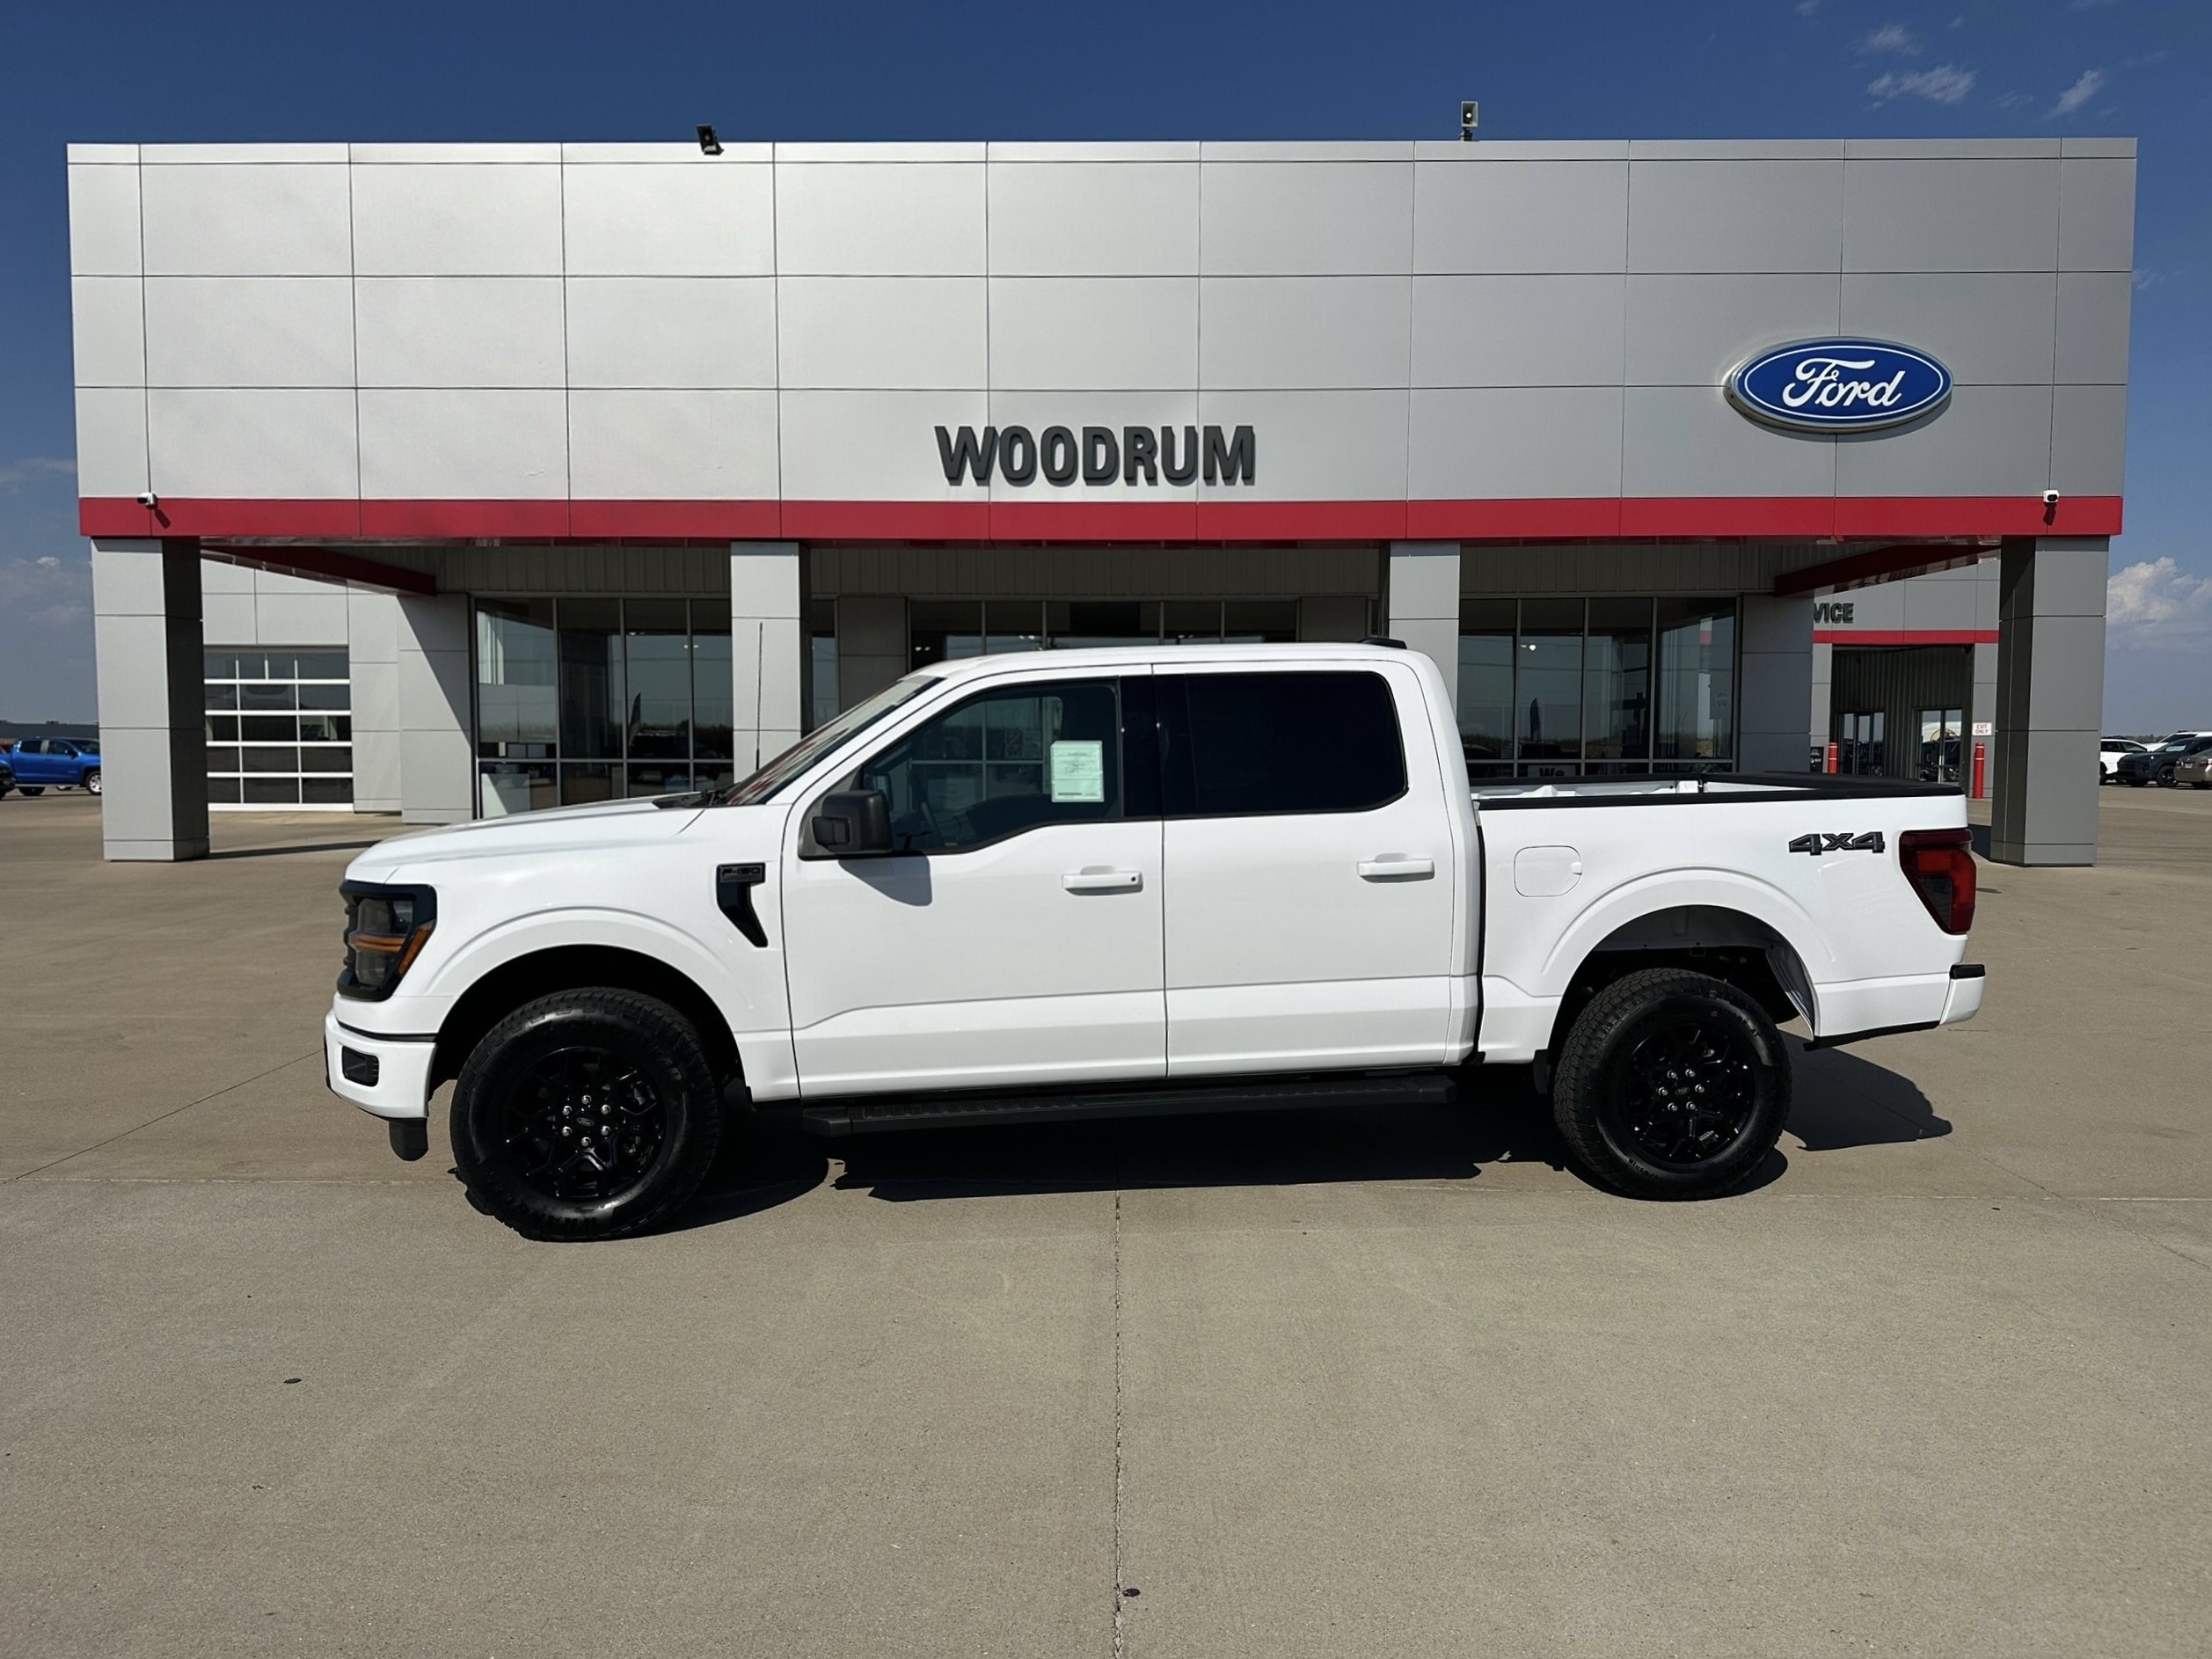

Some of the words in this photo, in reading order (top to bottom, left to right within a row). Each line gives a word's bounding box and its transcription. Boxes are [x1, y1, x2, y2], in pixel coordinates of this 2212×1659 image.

[1782, 357, 1906, 407] Ford
[934, 426, 1256, 486] WOODRUM
[1814, 602, 1854, 624] VICE
